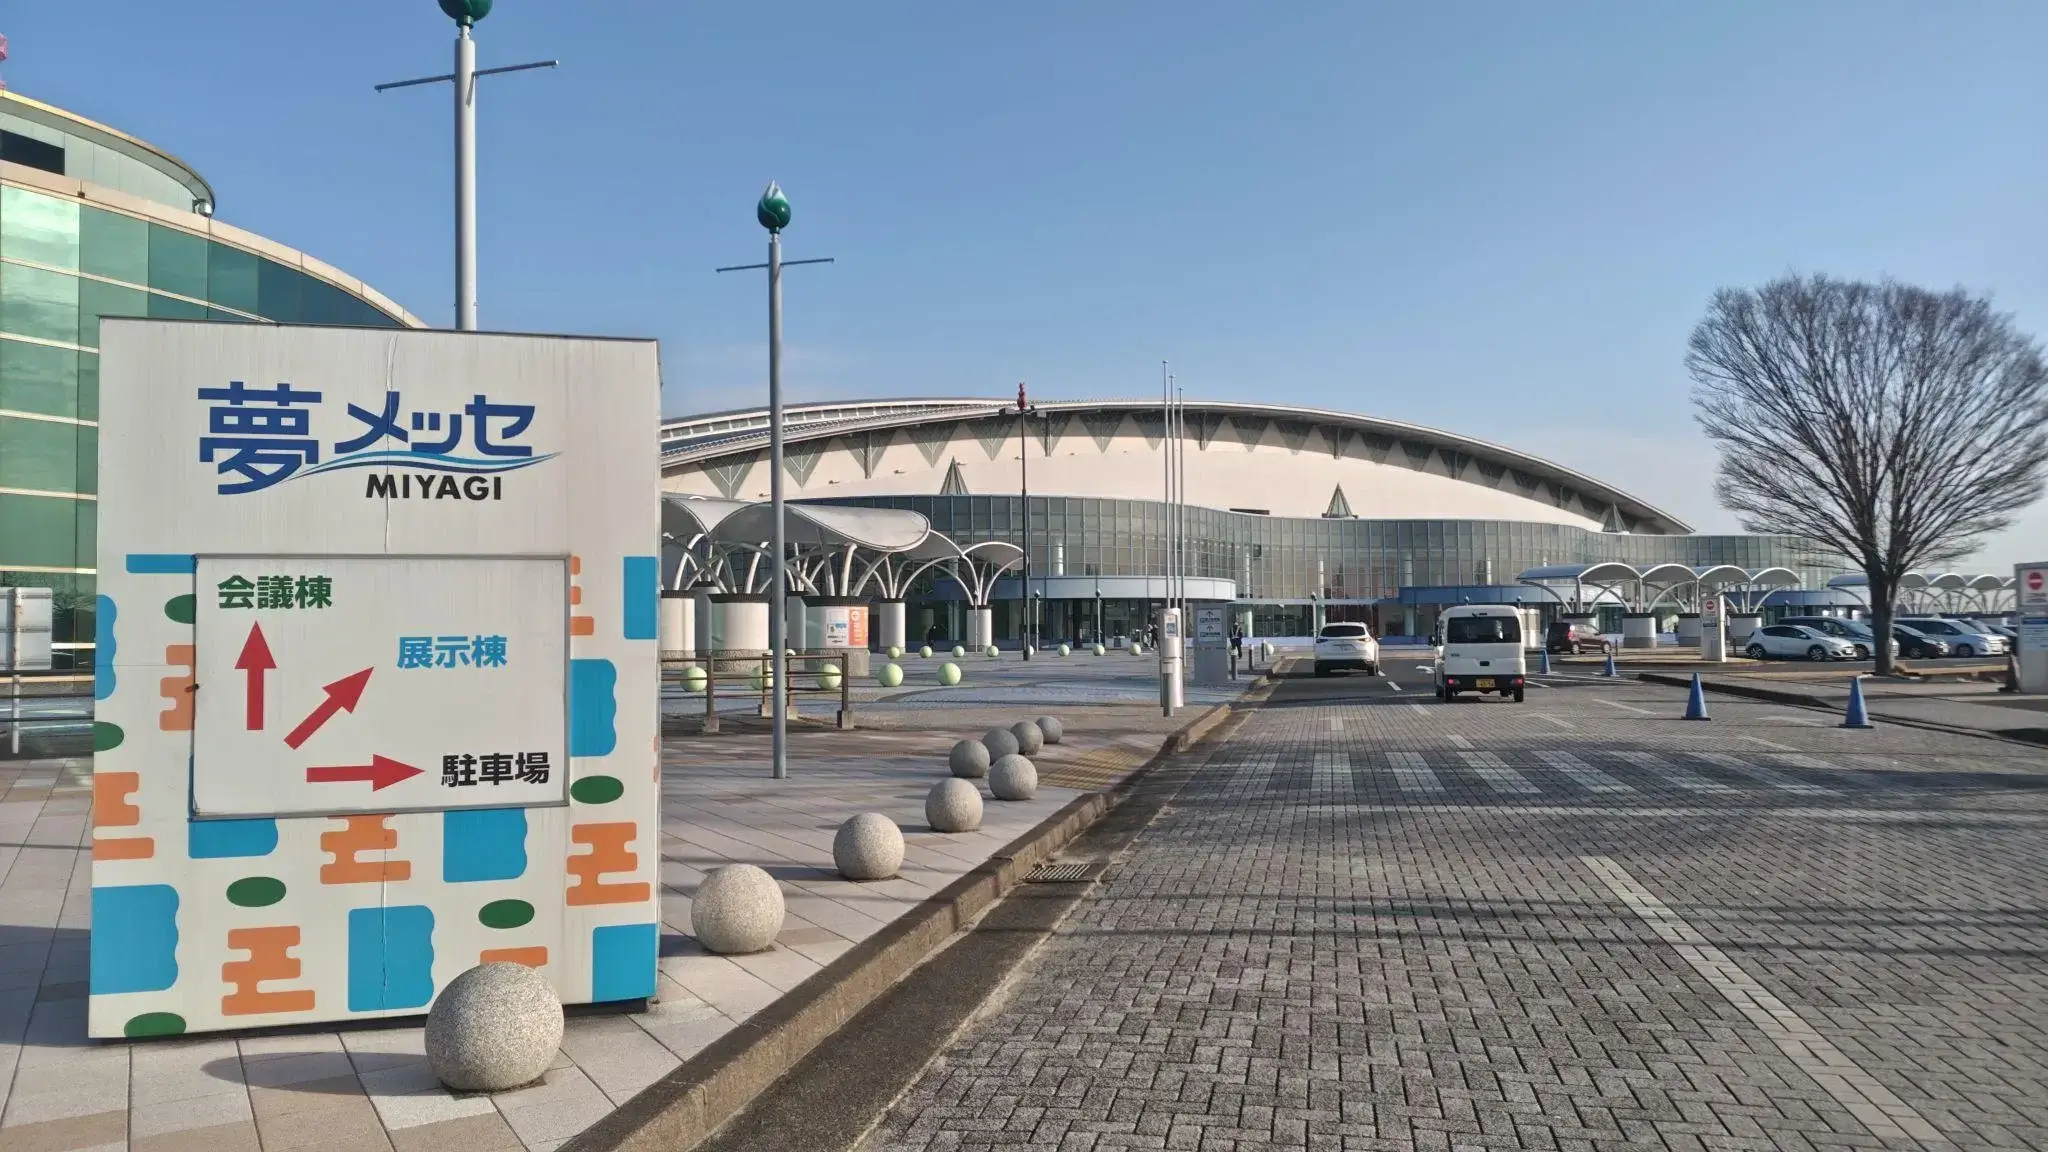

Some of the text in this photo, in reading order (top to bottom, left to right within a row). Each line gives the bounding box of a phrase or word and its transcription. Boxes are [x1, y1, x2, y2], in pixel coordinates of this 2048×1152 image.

[199, 382, 535, 494] 夢メッセ
[366, 474, 502, 501] MIYAGI
[218, 575, 333, 609] 会議棟
[397, 635, 508, 670] 展示棟
[441, 752, 550, 788] 駐車場
